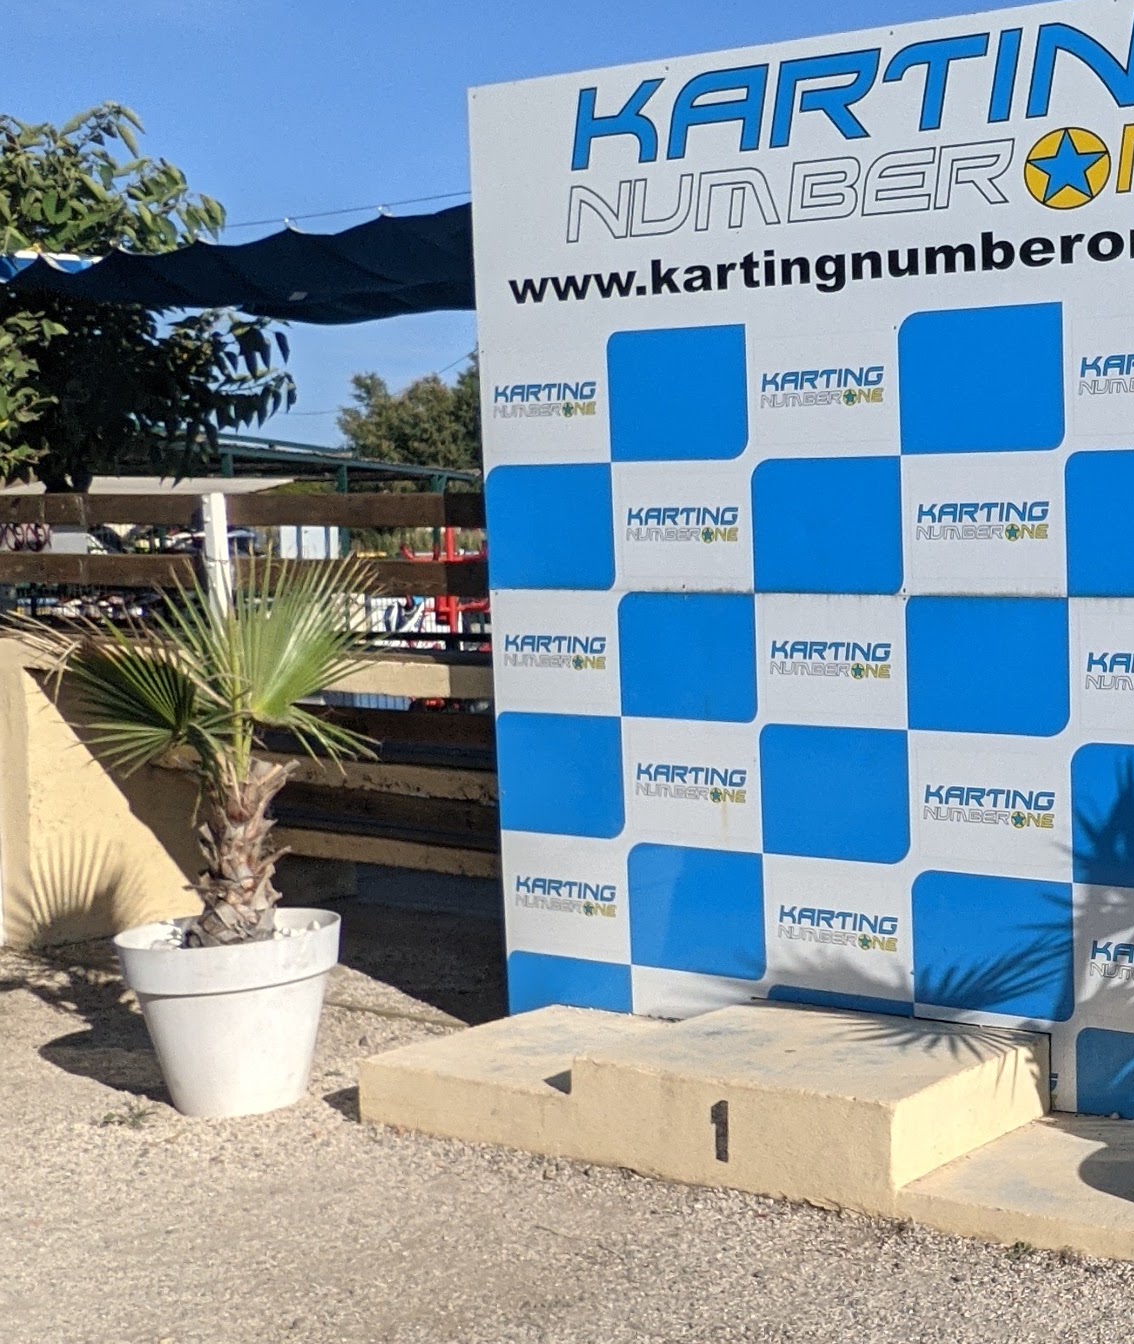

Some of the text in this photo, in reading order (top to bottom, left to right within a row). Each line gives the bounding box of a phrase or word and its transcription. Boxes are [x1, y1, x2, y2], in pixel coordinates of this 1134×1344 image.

[761, 366, 884, 392] KARTING
[494, 381, 597, 403] KARTING
[627, 506, 739, 527] KARTING
[917, 501, 1049, 524] KARTING
[504, 634, 606, 655] KARTING
[770, 640, 892, 662] KARTING
[636, 763, 747, 788] KARTING
[924, 784, 1055, 812] KARTING
[515, 875, 616, 903] KARTING
[779, 905, 898, 935] KARTING
[711, 1099, 729, 1162] 1
